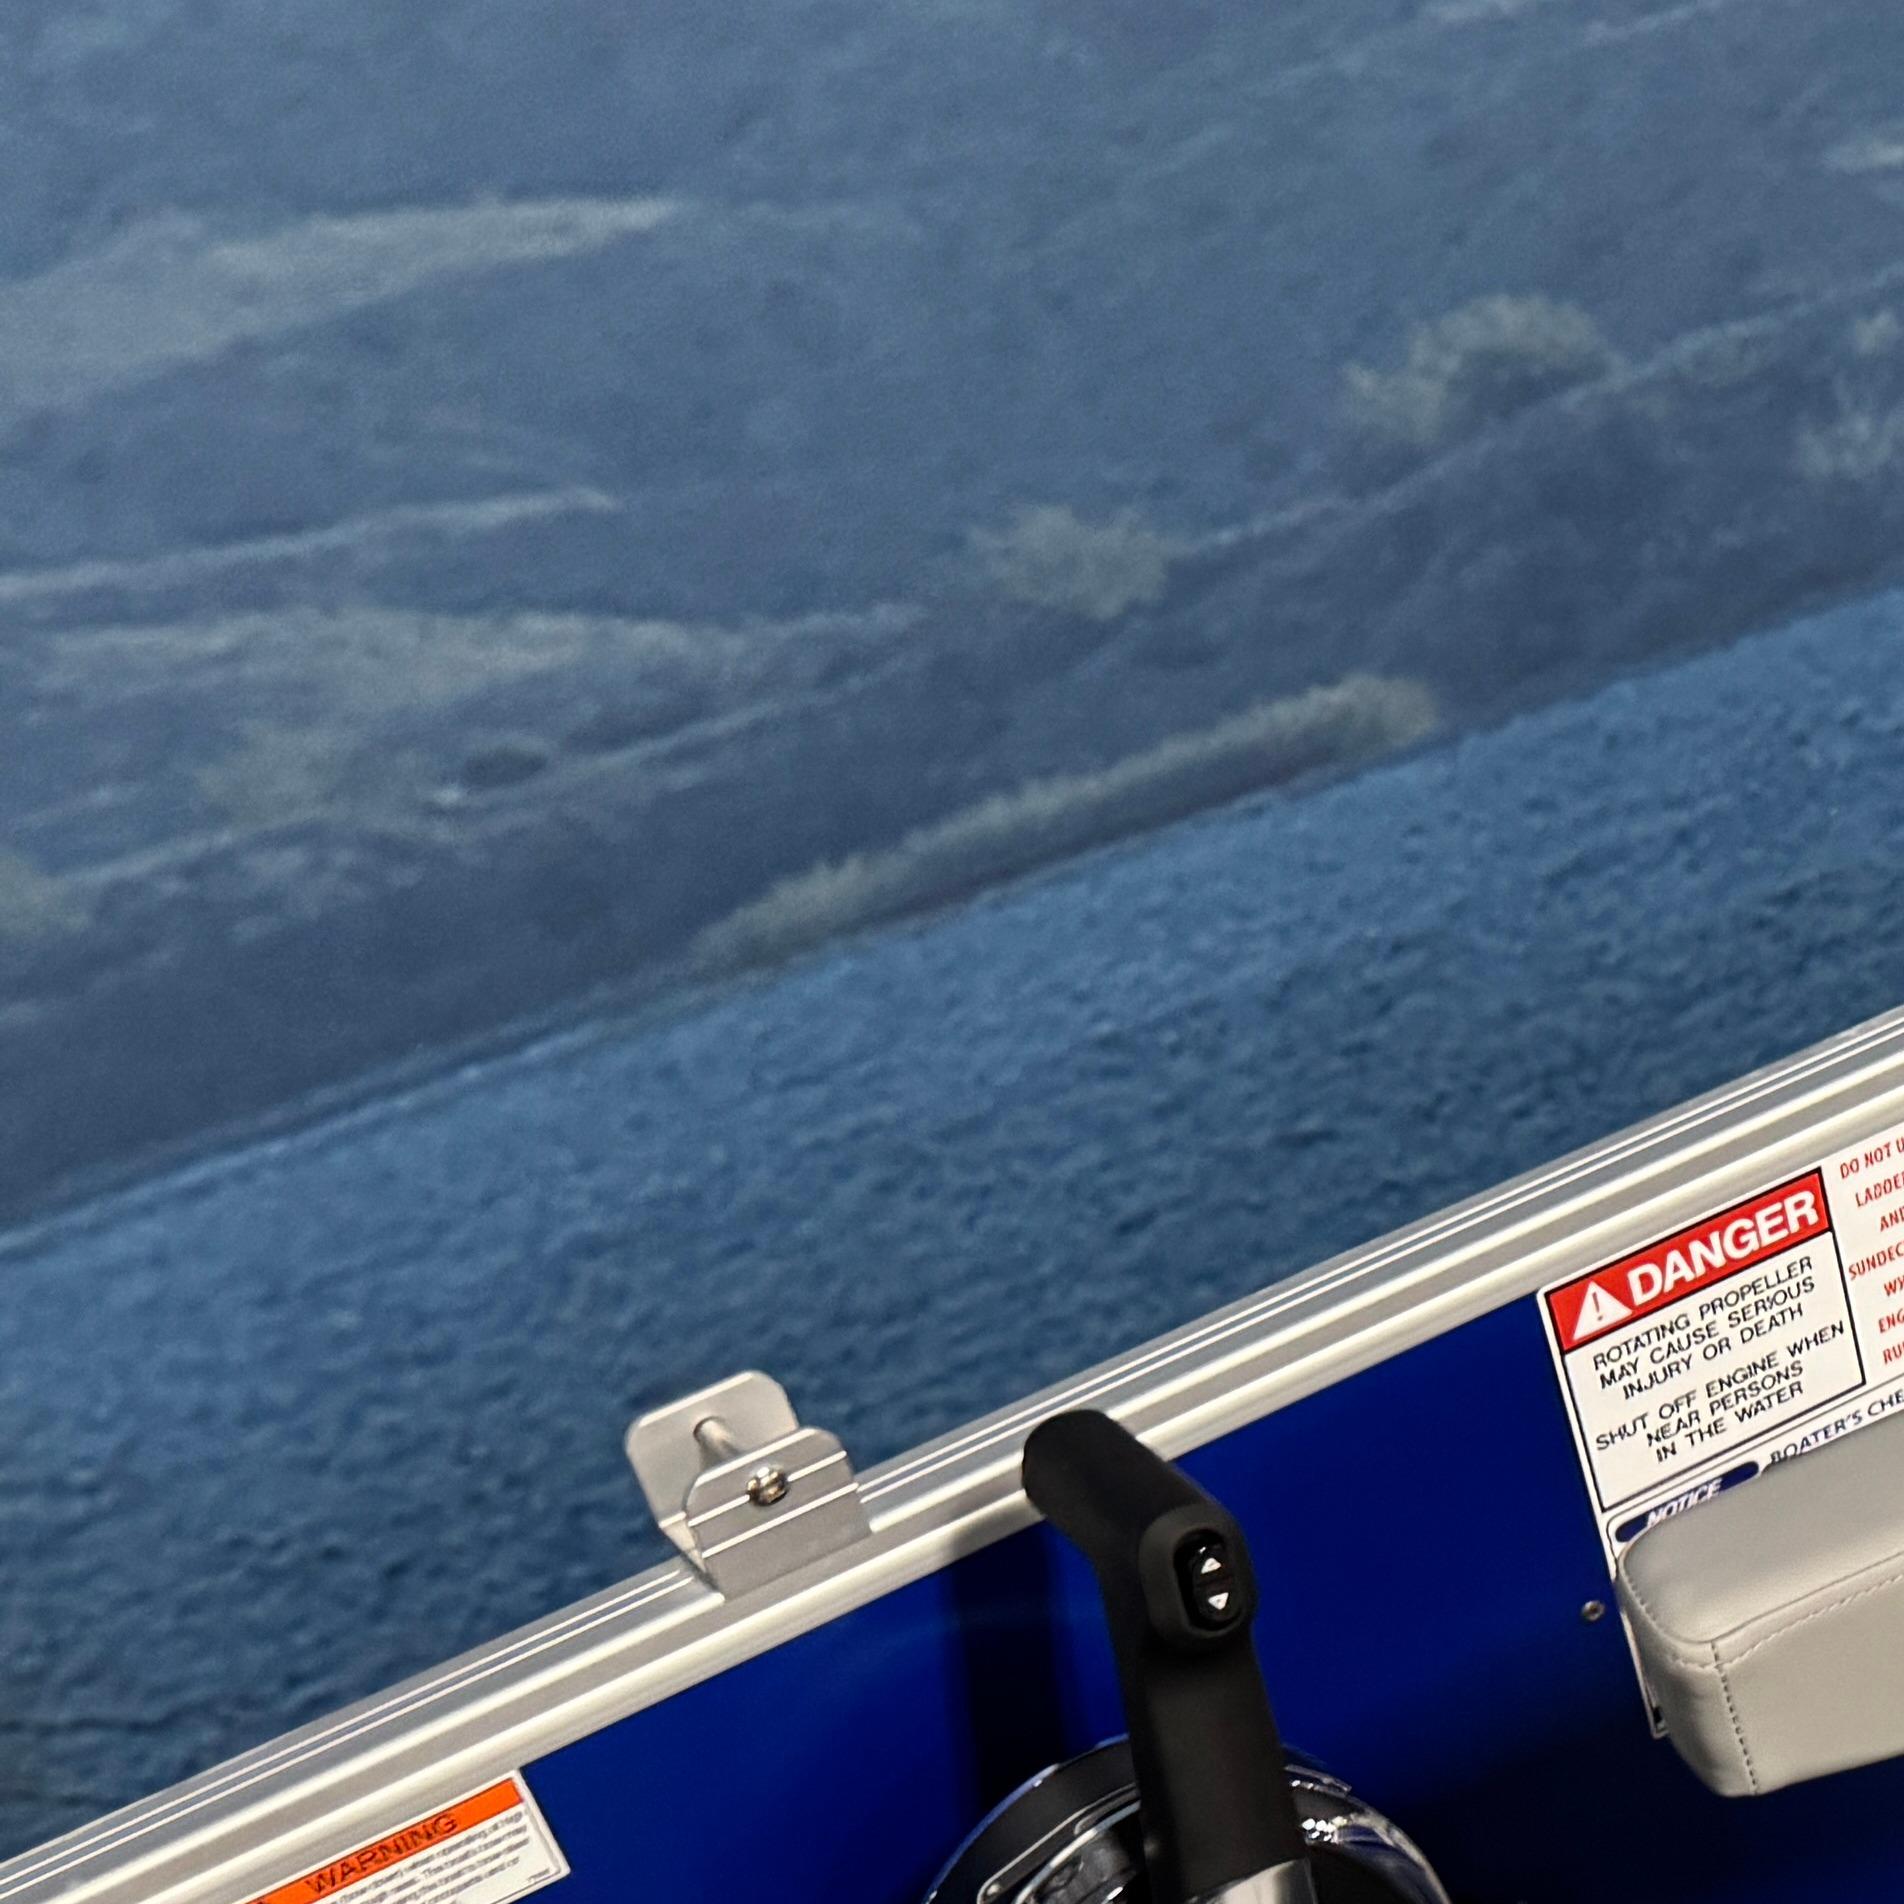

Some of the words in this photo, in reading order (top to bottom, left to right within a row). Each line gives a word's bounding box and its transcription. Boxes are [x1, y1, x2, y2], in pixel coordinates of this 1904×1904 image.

[1840, 1158, 1859, 1179] DO
[1865, 1143, 1890, 1168] NOT
[1628, 1191, 1818, 1305] DANGER
[1593, 1314, 1694, 1370] ROTATING
[1699, 1256, 1812, 1320] PROPELLER
[1600, 1357, 1638, 1389] MAY
[1650, 1321, 1718, 1364] CAUSE
[1728, 1276, 1814, 1328] SERIOUS
[1623, 1354, 1691, 1399] INJURY
[1703, 1337, 1731, 1360] OR
[1740, 1303, 1802, 1344] DEATH
[1596, 1413, 1647, 1450] SHUT
[1659, 1390, 1695, 1419] OFF
[1706, 1352, 1780, 1398] ENGINE
[1787, 1321, 1844, 1362] WHEN
[1647, 1410, 1700, 1447] NEAR
[1708, 1361, 1803, 1416] PERSONS
[1657, 1442, 1676, 1462] IN
[1685, 1418, 1725, 1446] THE
[1732, 1381, 1803, 1422] WATER
[1647, 1477, 1722, 1527] NOTICE
[1770, 1411, 1862, 1464] BOATER'S
[305, 1812, 460, 1895] WARNING
